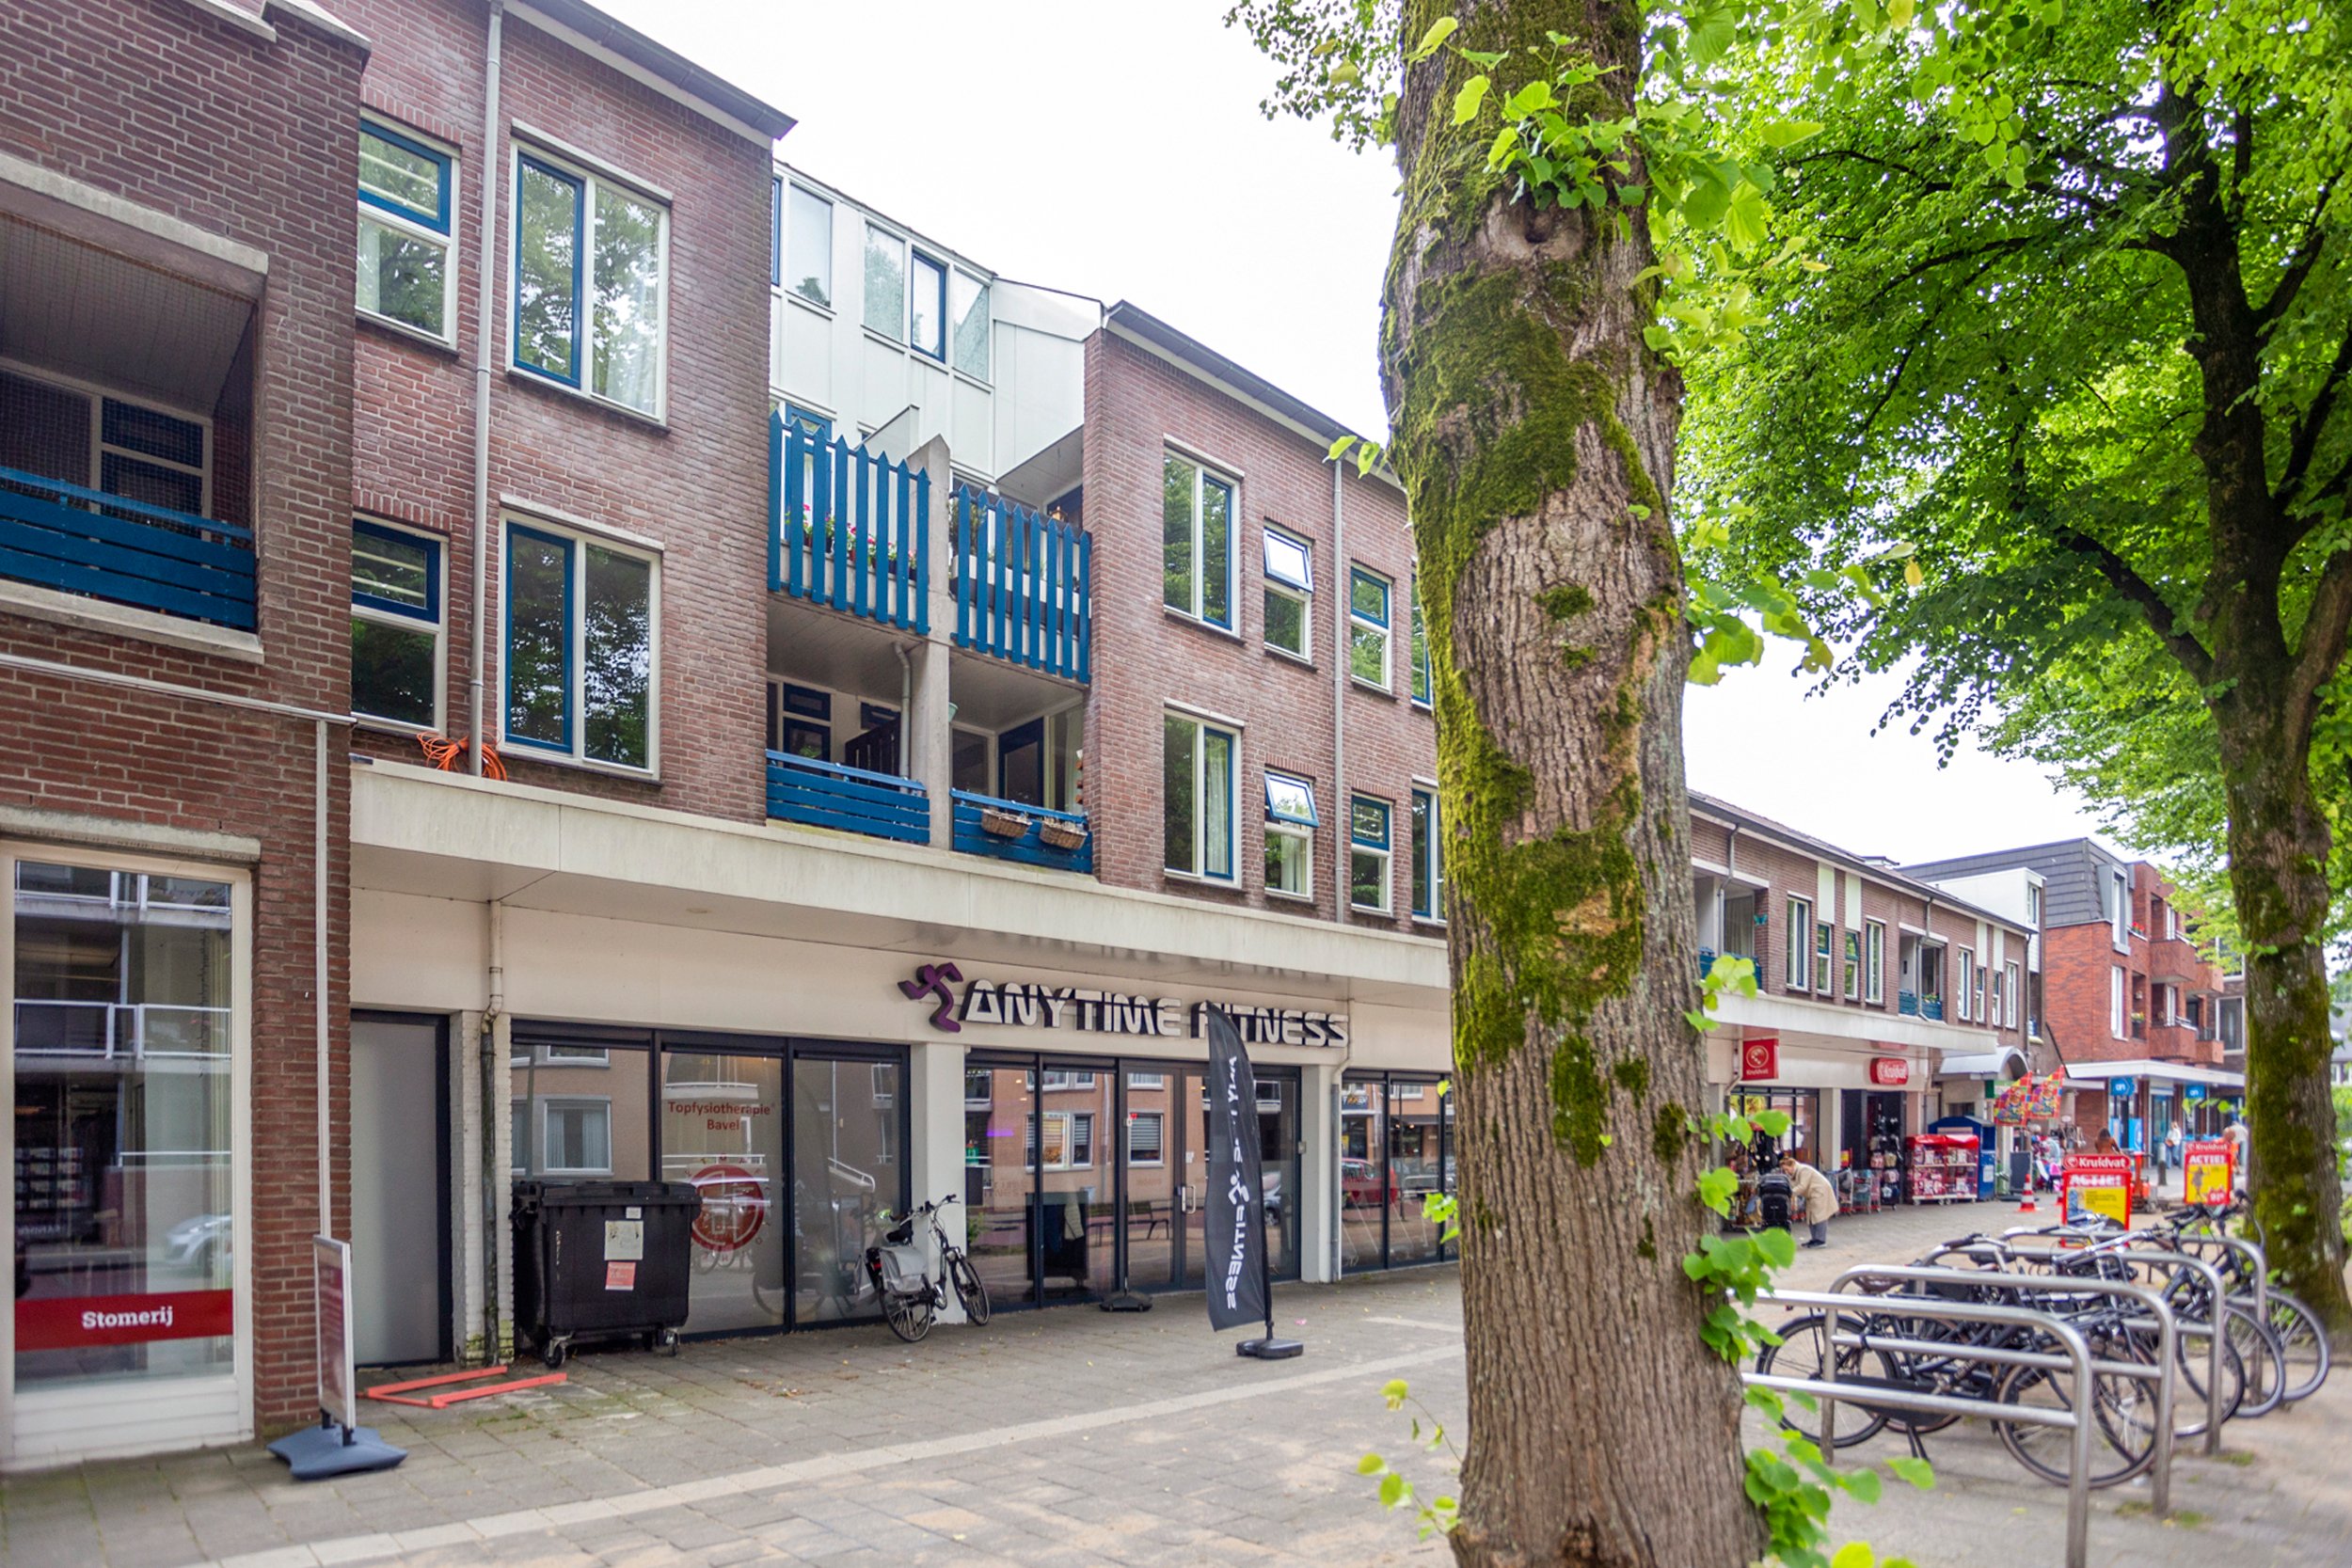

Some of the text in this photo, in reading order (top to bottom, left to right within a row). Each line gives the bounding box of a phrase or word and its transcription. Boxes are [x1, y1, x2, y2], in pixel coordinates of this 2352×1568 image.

[960, 978, 1182, 1037] ANYTIME
[668, 1101, 771, 1116] Topfysiotherapie
[707, 1118, 739, 1131] Bavel
[2078, 1156, 2126, 1167] Kruidvat
[82, 1306, 173, 1329] Stomerij
